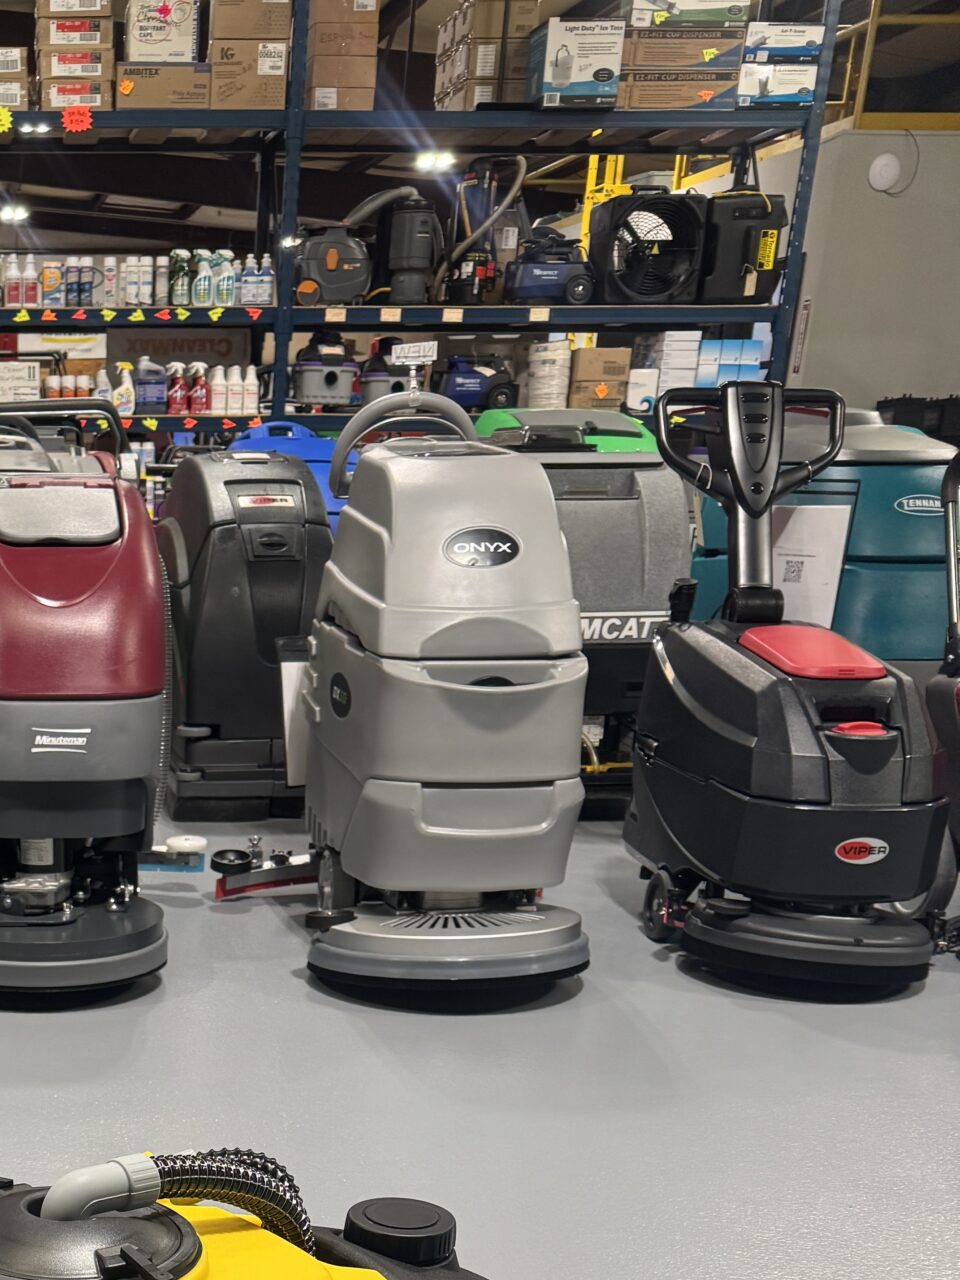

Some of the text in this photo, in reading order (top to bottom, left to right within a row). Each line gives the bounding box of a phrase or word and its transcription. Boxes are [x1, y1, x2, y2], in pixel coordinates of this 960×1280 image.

[565, 25, 580, 33] Light
[640, 31, 663, 39] EZ-FIT
[666, 31, 682, 39] CUP
[123, 68, 161, 76] AMBITEX
[636, 73, 659, 81] EZ-FIT
[661, 73, 677, 81] CUP
[902, 498, 942, 511] TENNAN
[453, 542, 513, 553] ONYX
[580, 616, 656, 641] MCAT
[34, 735, 88, 746] Minuteman
[842, 846, 888, 855] VIPER
